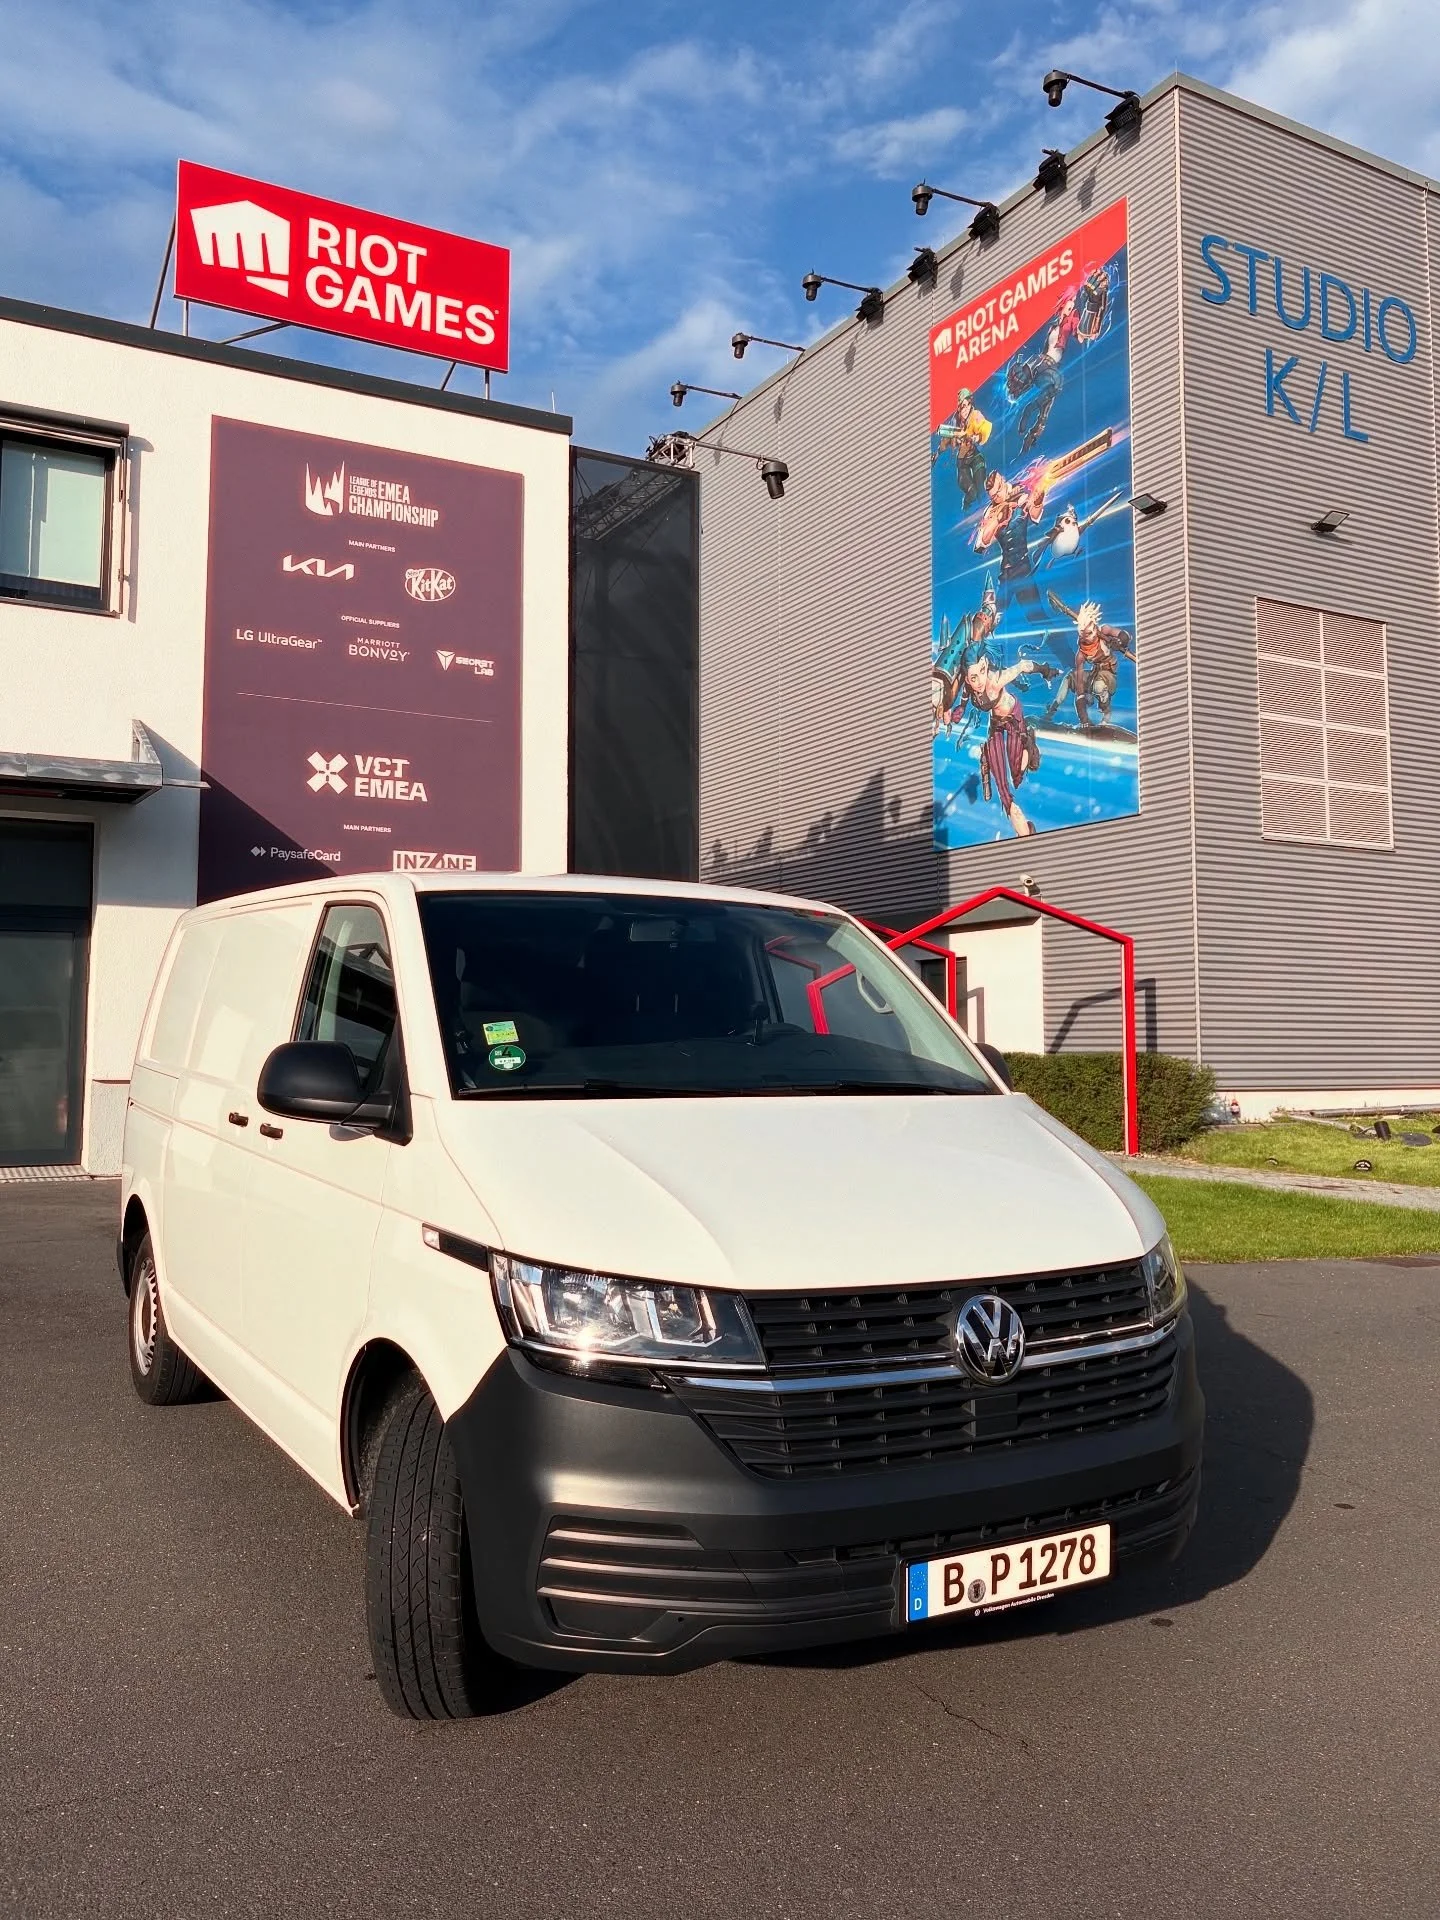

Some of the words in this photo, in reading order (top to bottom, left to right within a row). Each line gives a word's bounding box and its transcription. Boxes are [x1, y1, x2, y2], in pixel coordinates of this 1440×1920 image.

[308, 217, 427, 285] RIOT
[955, 299, 997, 344] RIOT
[999, 249, 1073, 314] GAMES
[1201, 234, 1417, 364] STUDIO
[305, 265, 495, 345] GAMES
[956, 312, 1019, 369] ARENA
[349, 475, 370, 487] LEAGUE
[371, 479, 378, 488] OF
[349, 484, 377, 498] LEGENDS
[378, 481, 410, 504] EMEA
[349, 495, 439, 527] CHAMPIONSHIP
[348, 540, 365, 548] MAIN
[365, 542, 396, 552] PARTNERS
[341, 615, 368, 624] OFFICIAL
[368, 619, 400, 628] SUPPLIERS
[236, 629, 254, 641] LG
[357, 637, 400, 648] MARRIOTT
[475, 667, 494, 676] LAB
[354, 754, 410, 778] VCT
[355, 777, 428, 802] EMEA
[360, 825, 392, 833] PARTNERS
[270, 847, 341, 861] PaysafeCard
[1036, 1593, 1055, 1601] Dresden
[914, 1598, 922, 1611] D
